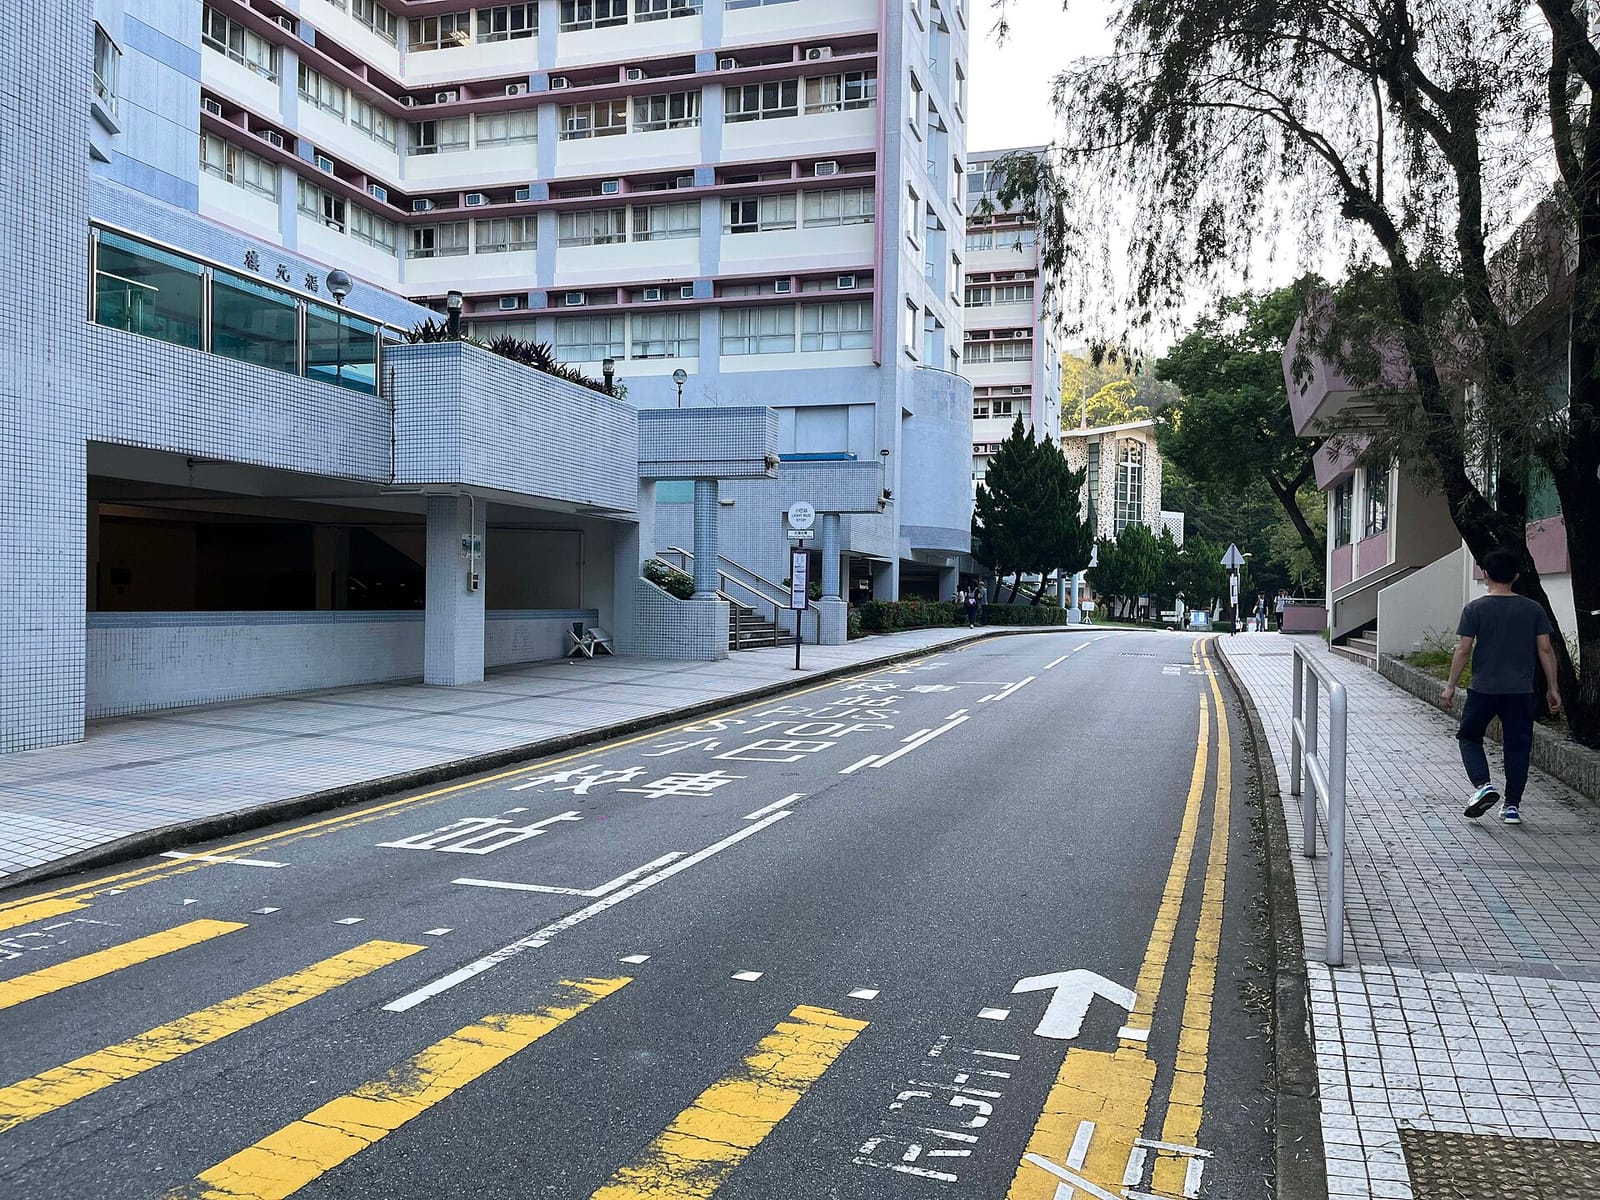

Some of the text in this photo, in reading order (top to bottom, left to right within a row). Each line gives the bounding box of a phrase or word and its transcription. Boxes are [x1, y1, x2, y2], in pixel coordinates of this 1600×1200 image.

[682, 718, 895, 738] STOP
[641, 737, 838, 763] 小巴
[506, 763, 749, 799] 校車
[374, 807, 584, 855] 站
